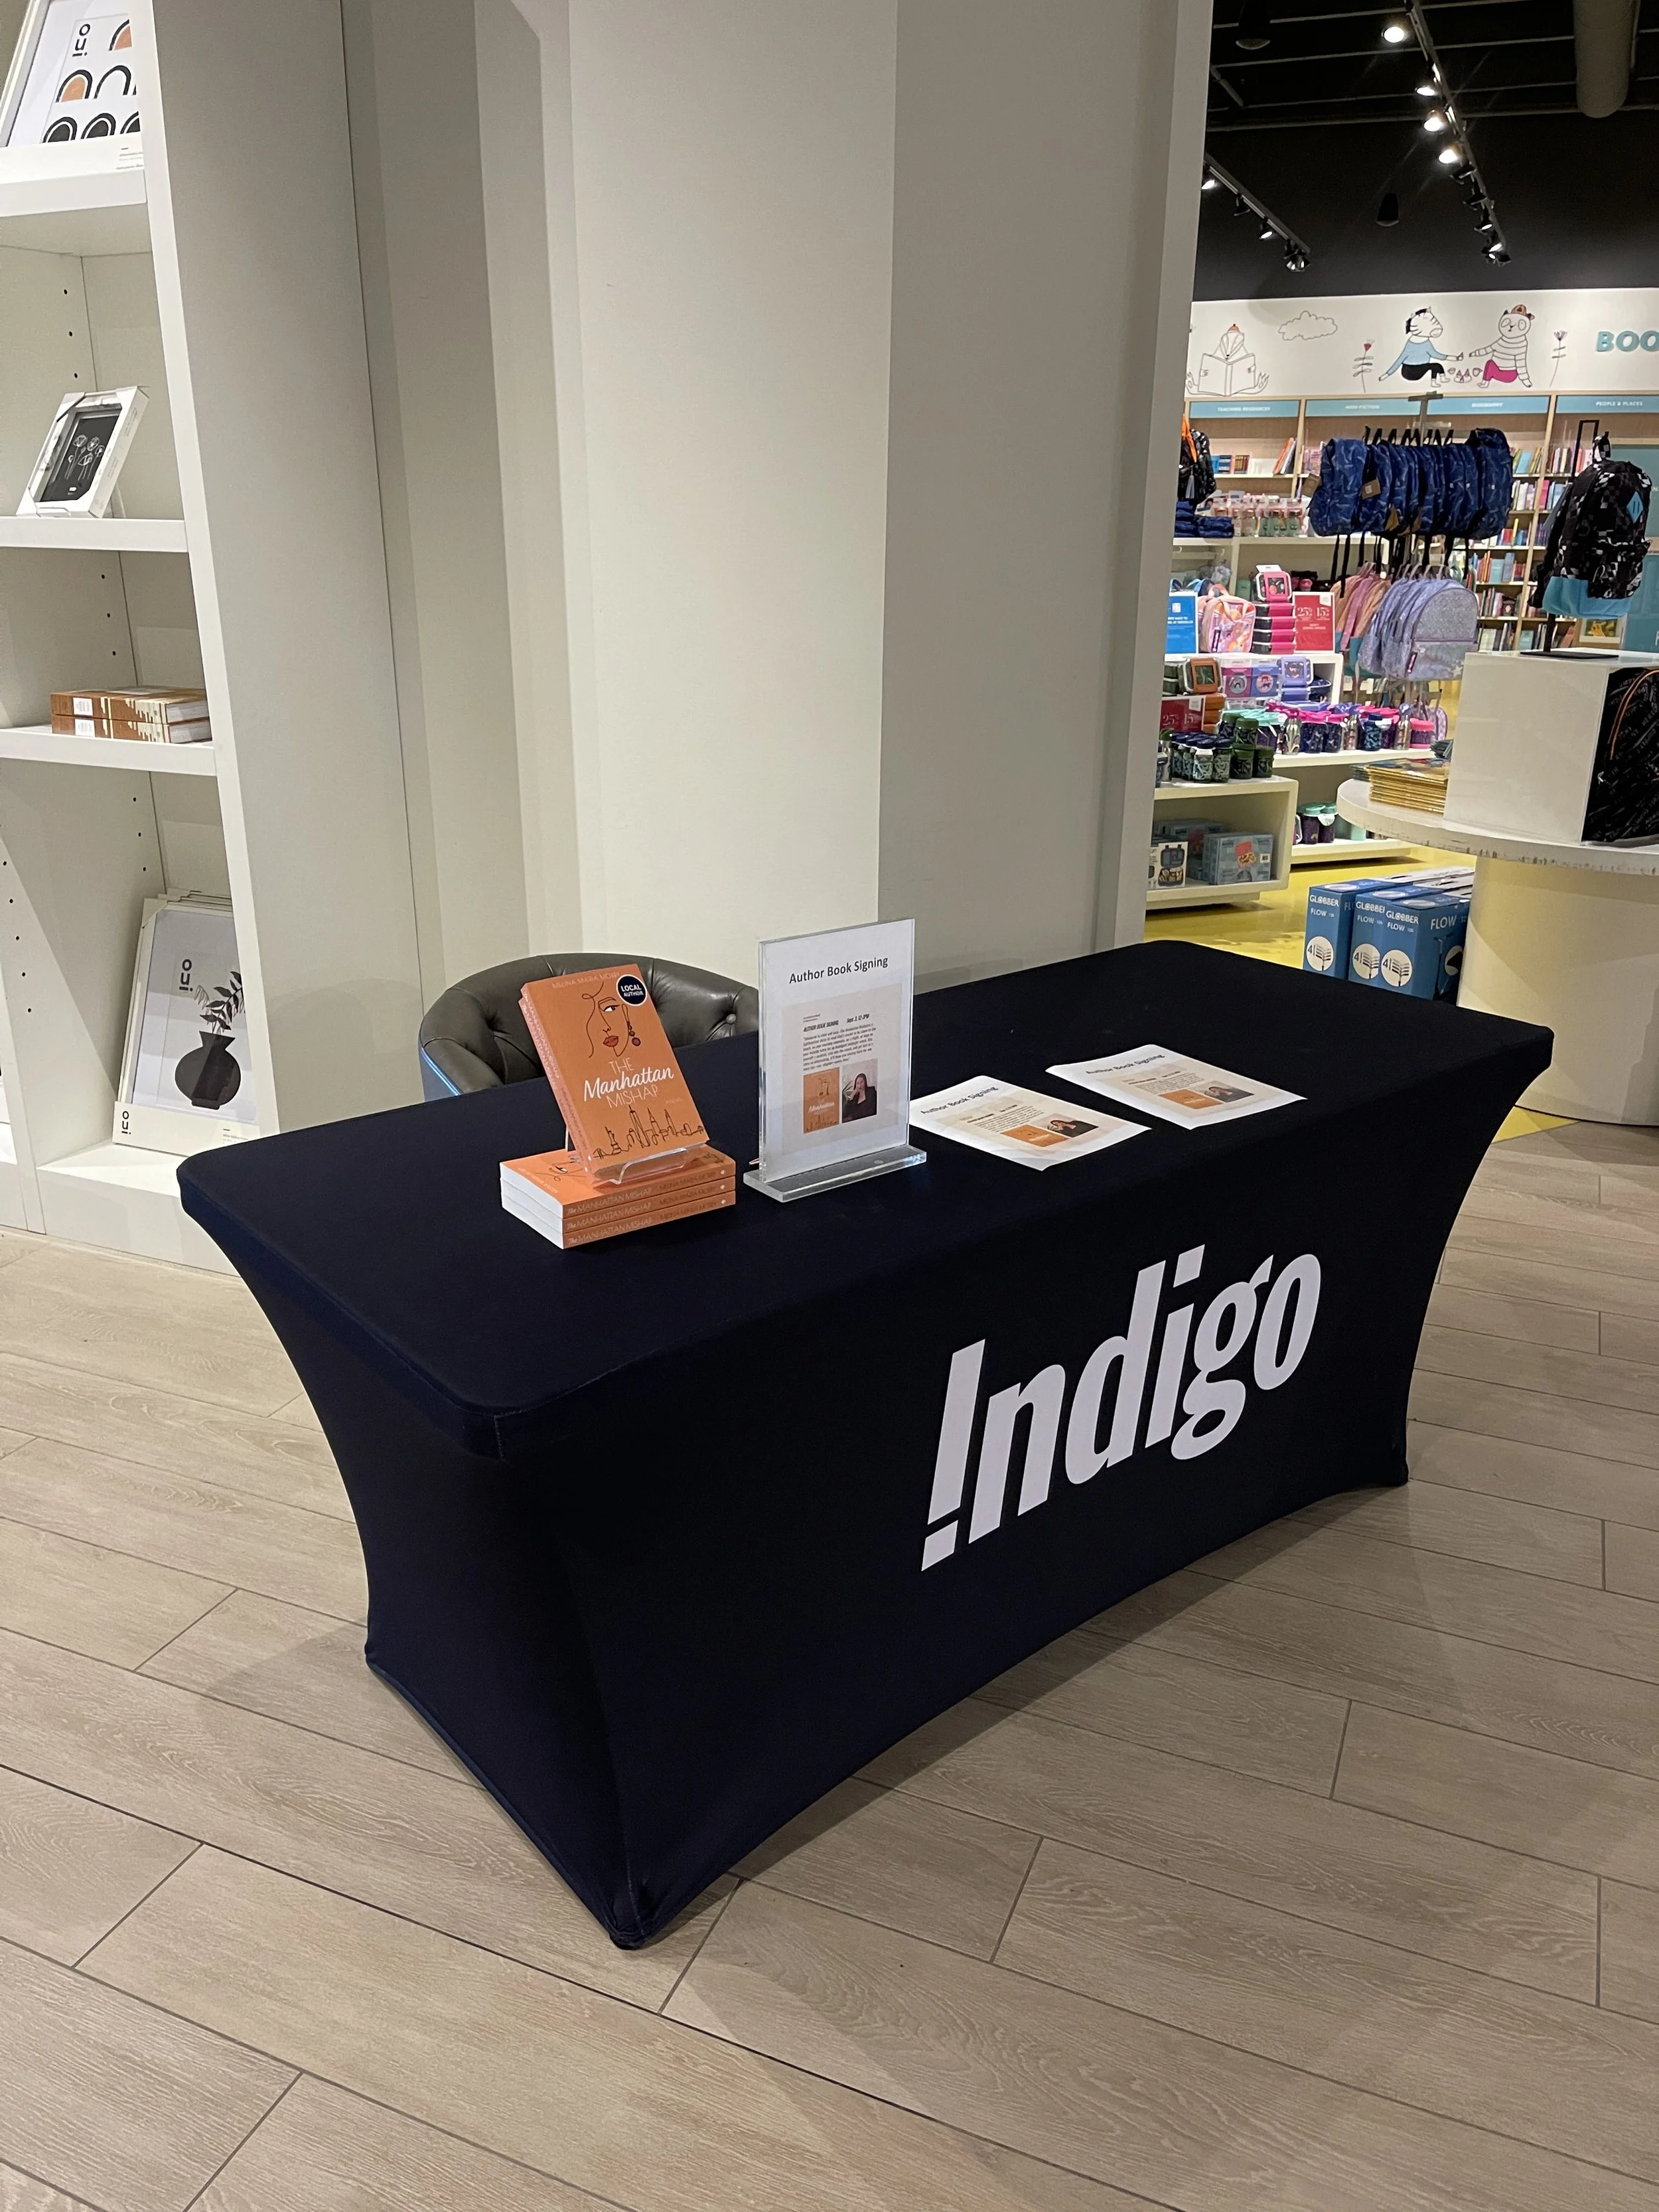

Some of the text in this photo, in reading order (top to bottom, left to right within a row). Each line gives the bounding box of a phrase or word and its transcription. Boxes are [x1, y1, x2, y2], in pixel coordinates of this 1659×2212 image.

[72, 24, 91, 57] oui
[1309, 894, 1339, 907] GLOBBER
[1311, 908, 1327, 917] FLOW
[1357, 915, 1375, 924] FLOW
[1386, 910, 1419, 924] GLOBBER
[1387, 922, 1406, 931] FLOW
[1430, 915, 1457, 930] FLOW
[179, 958, 193, 992] oui
[789, 956, 888, 984] Author Book Signing
[620, 984, 642, 992] LOCAL
[608, 1057, 636, 1075] THE
[1134, 1054, 1165, 1065] Signing
[584, 1067, 674, 1102] Manhattan
[606, 1084, 658, 1109] MISHAP
[920, 1086, 999, 1114] Author Book Signing
[121, 1110, 131, 1135] oui
